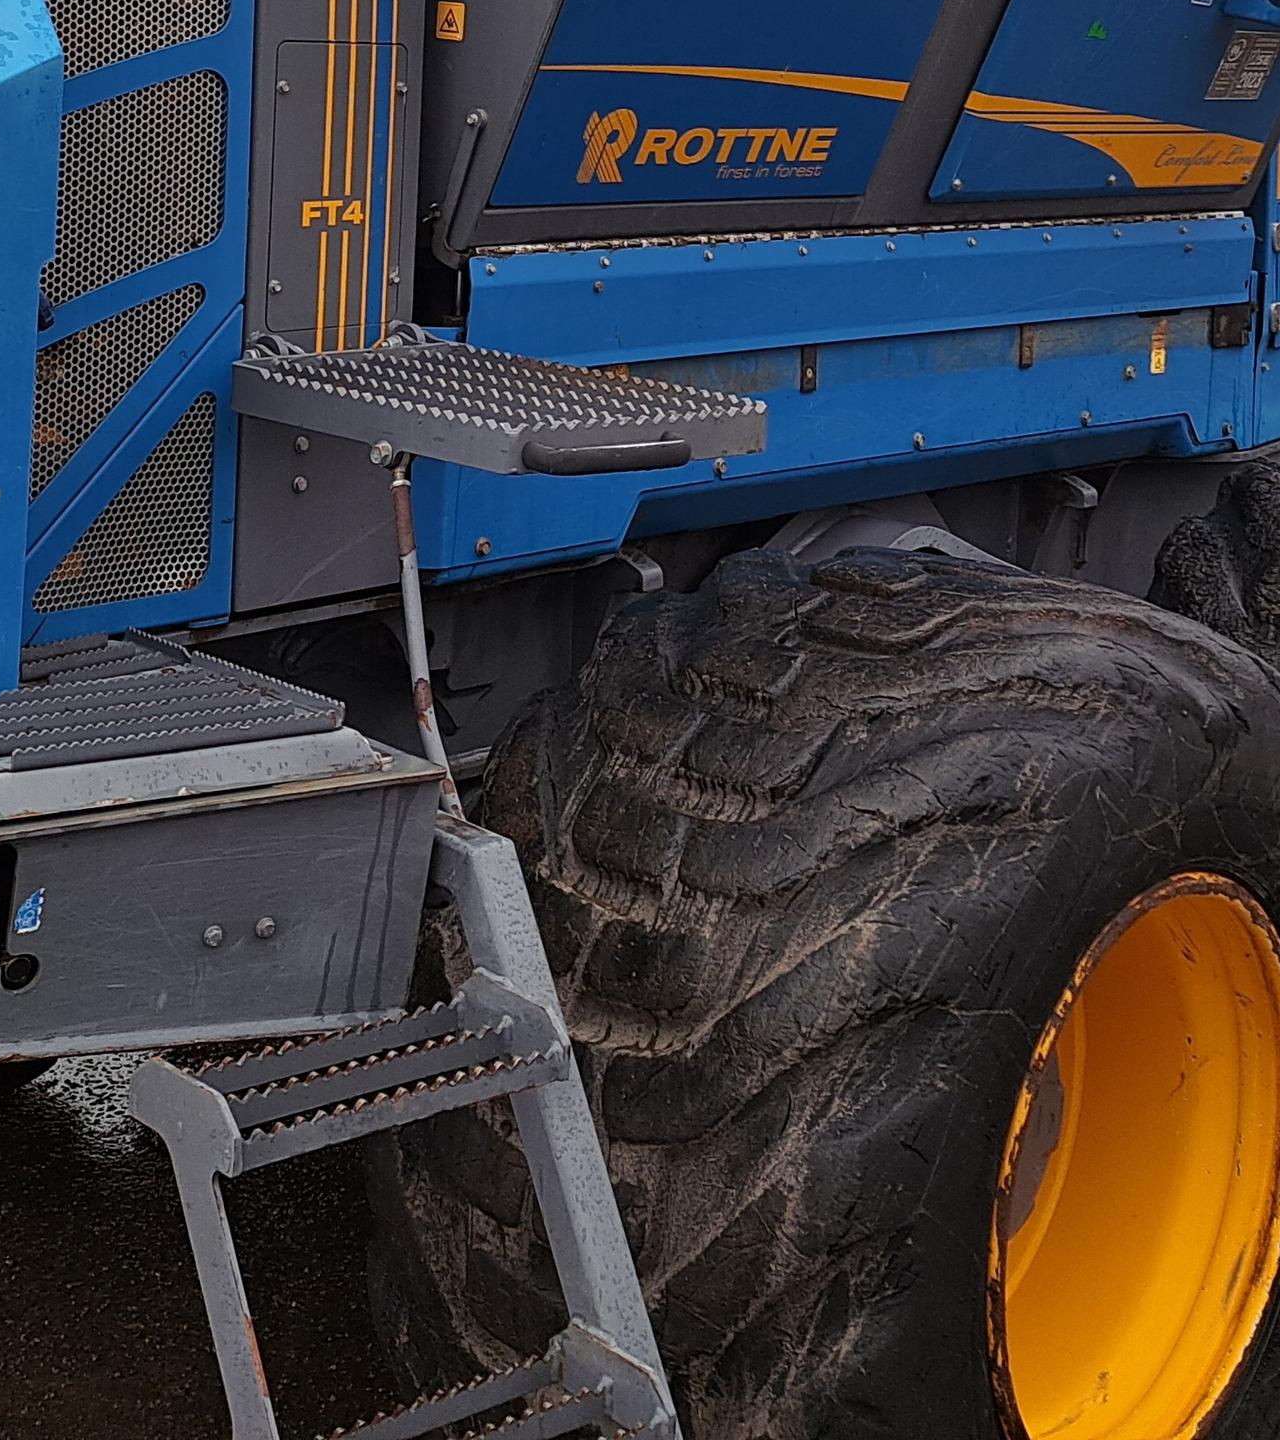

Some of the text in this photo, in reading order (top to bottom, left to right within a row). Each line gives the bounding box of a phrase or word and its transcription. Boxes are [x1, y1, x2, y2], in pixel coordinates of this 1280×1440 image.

[634, 127, 838, 165] ROTTNE
[715, 164, 823, 179] first in forest
[302, 200, 364, 227] FT4
